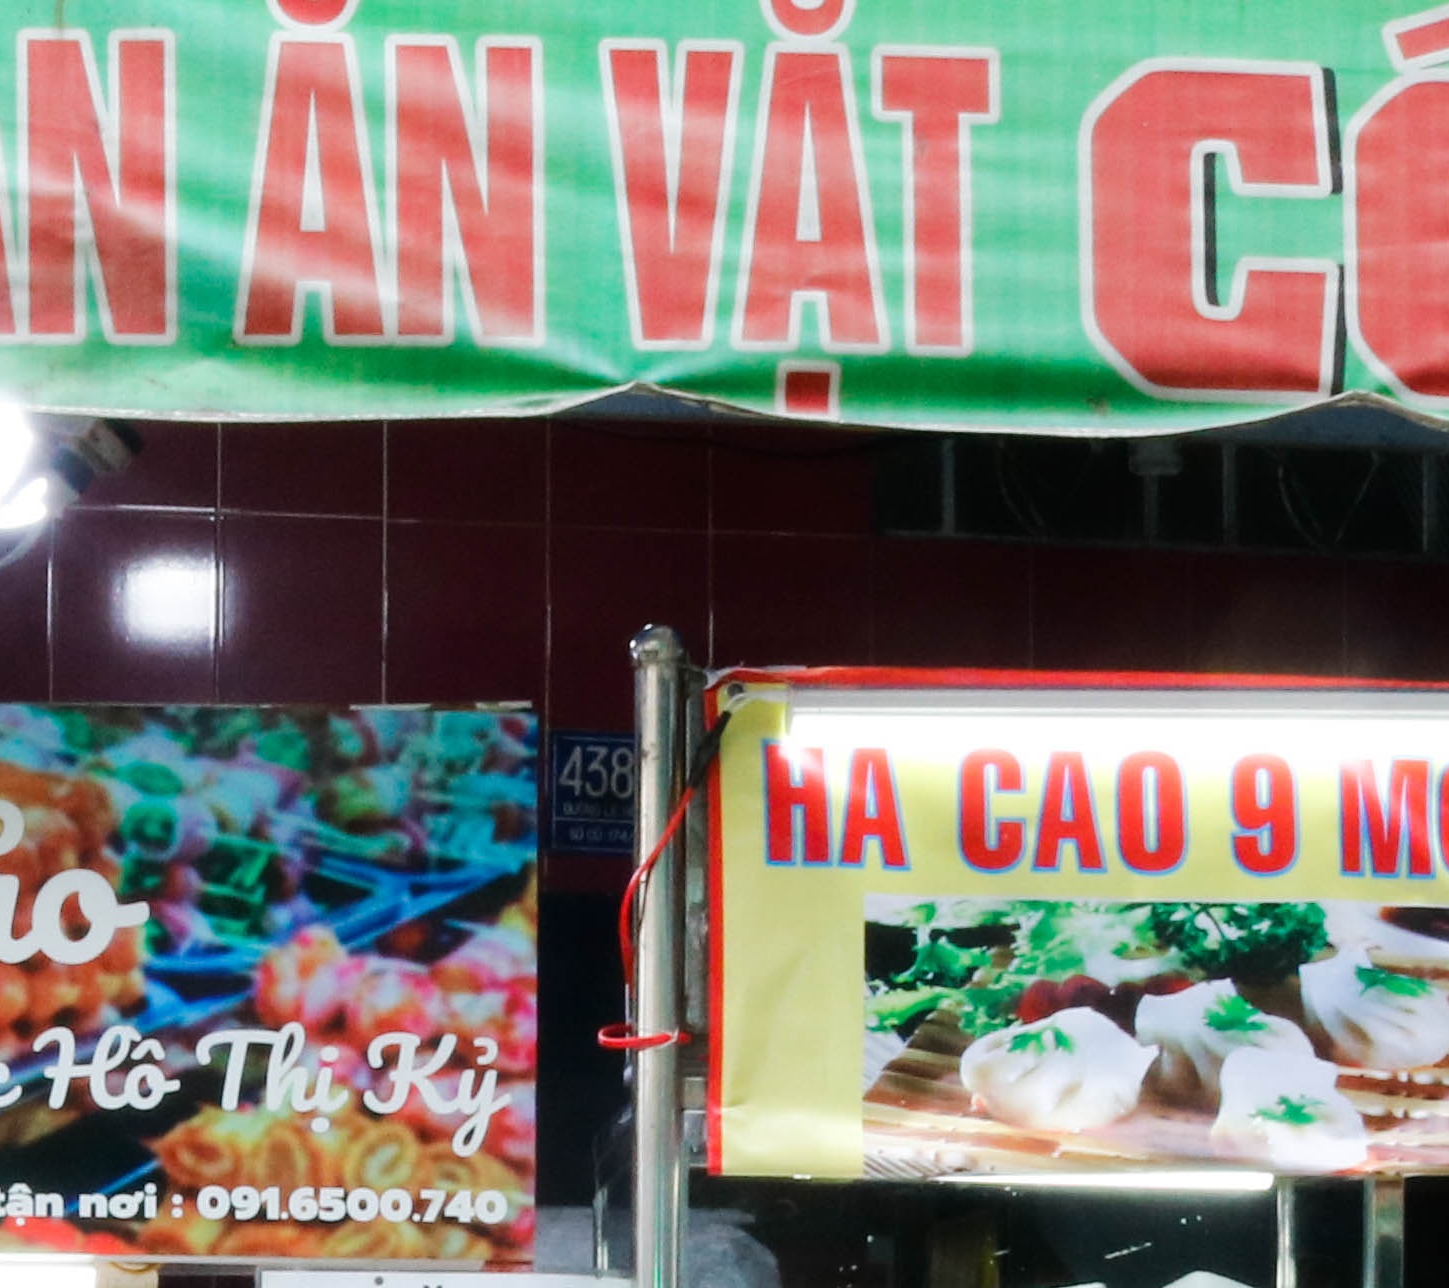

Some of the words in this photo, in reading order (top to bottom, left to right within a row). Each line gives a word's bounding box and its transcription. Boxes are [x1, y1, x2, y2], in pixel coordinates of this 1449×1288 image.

[235, 0, 544, 348] ĂN
[601, 0, 1002, 421] VẶT
[557, 744, 635, 799] 438
[1231, 751, 1299, 878] 9
[24, 1024, 180, 1111] Hồ
[197, 1022, 349, 1134] Thị
[363, 1031, 511, 1158] Kỷ
[79, 1182, 158, 1221] nơi
[197, 1185, 509, 1226] 091.6500.740
